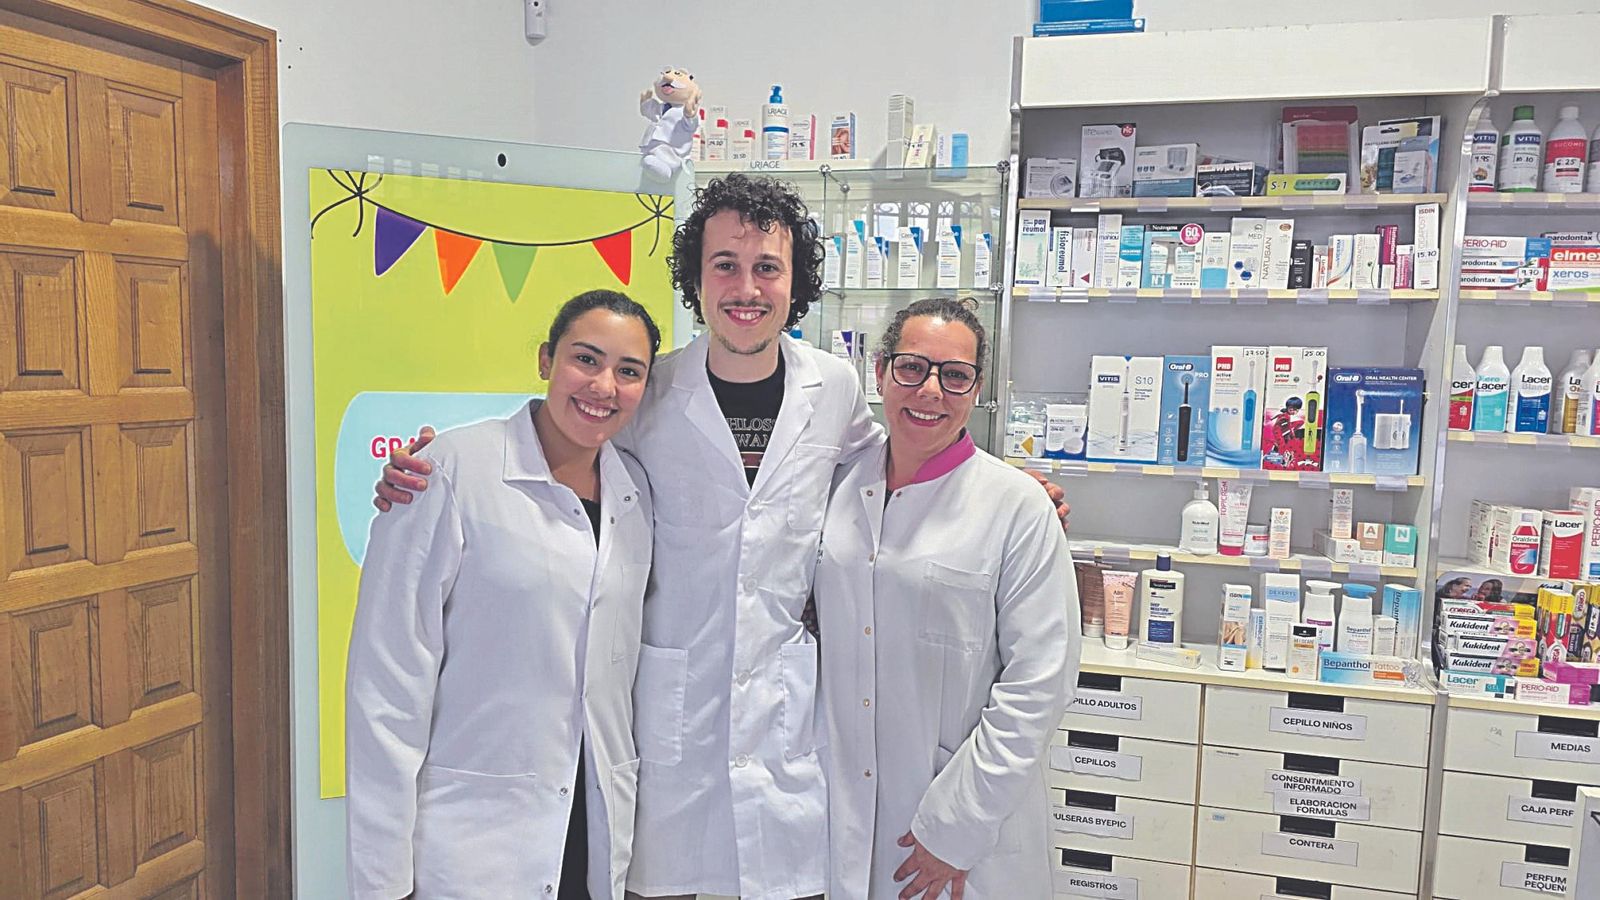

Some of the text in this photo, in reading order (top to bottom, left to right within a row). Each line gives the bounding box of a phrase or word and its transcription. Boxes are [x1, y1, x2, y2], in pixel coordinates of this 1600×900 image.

[767, 108, 788, 116] URIAGE
[1473, 133, 1496, 141] VITIS
[750, 160, 780, 170] URIAGE
[1033, 219, 1047, 227] pan
[1022, 225, 1046, 233] reumol
[1185, 226, 1199, 237] 60
[1058, 230, 1069, 273] fisioreumol
[1553, 249, 1600, 261] elme
[1552, 270, 1589, 279] xeros
[1135, 376, 1154, 385] S10
[1452, 381, 1474, 389] cer
[1521, 375, 1552, 384] Lacer
[1476, 381, 1507, 390] Lacer
[726, 418, 776, 431] HLOS
[371, 436, 416, 458] GR
[1555, 519, 1582, 529] Lacer
[1398, 528, 1408, 538] N
[1450, 620, 1489, 631] Kukident
[1462, 641, 1501, 651] Kukident
[1323, 659, 1400, 671] Bepanthol Tattoo
[1452, 659, 1492, 669] Kukident
[1447, 674, 1479, 685] Lacer
[1073, 697, 1137, 711] PILLO ADULTOS
[1283, 716, 1353, 731] CEPILLO NIÑOS
[1550, 742, 1592, 753] MEDIAS
[1074, 756, 1117, 768] CEPILLOS
[1271, 773, 1355, 789] CONSENTIMIENTO
[1283, 782, 1342, 795] INFORMADO
[1289, 797, 1357, 811] ELABORACION
[1296, 806, 1348, 817] FORMULAS
[1521, 804, 1575, 817] CAJA PERF
[1053, 812, 1127, 829] ULSERAS BYEPIC
[1289, 837, 1335, 850] CONTERA
[1526, 872, 1567, 884] PERFUM
[1070, 878, 1118, 891] REGISTROS
[1524, 881, 1567, 893] PEQUEN
